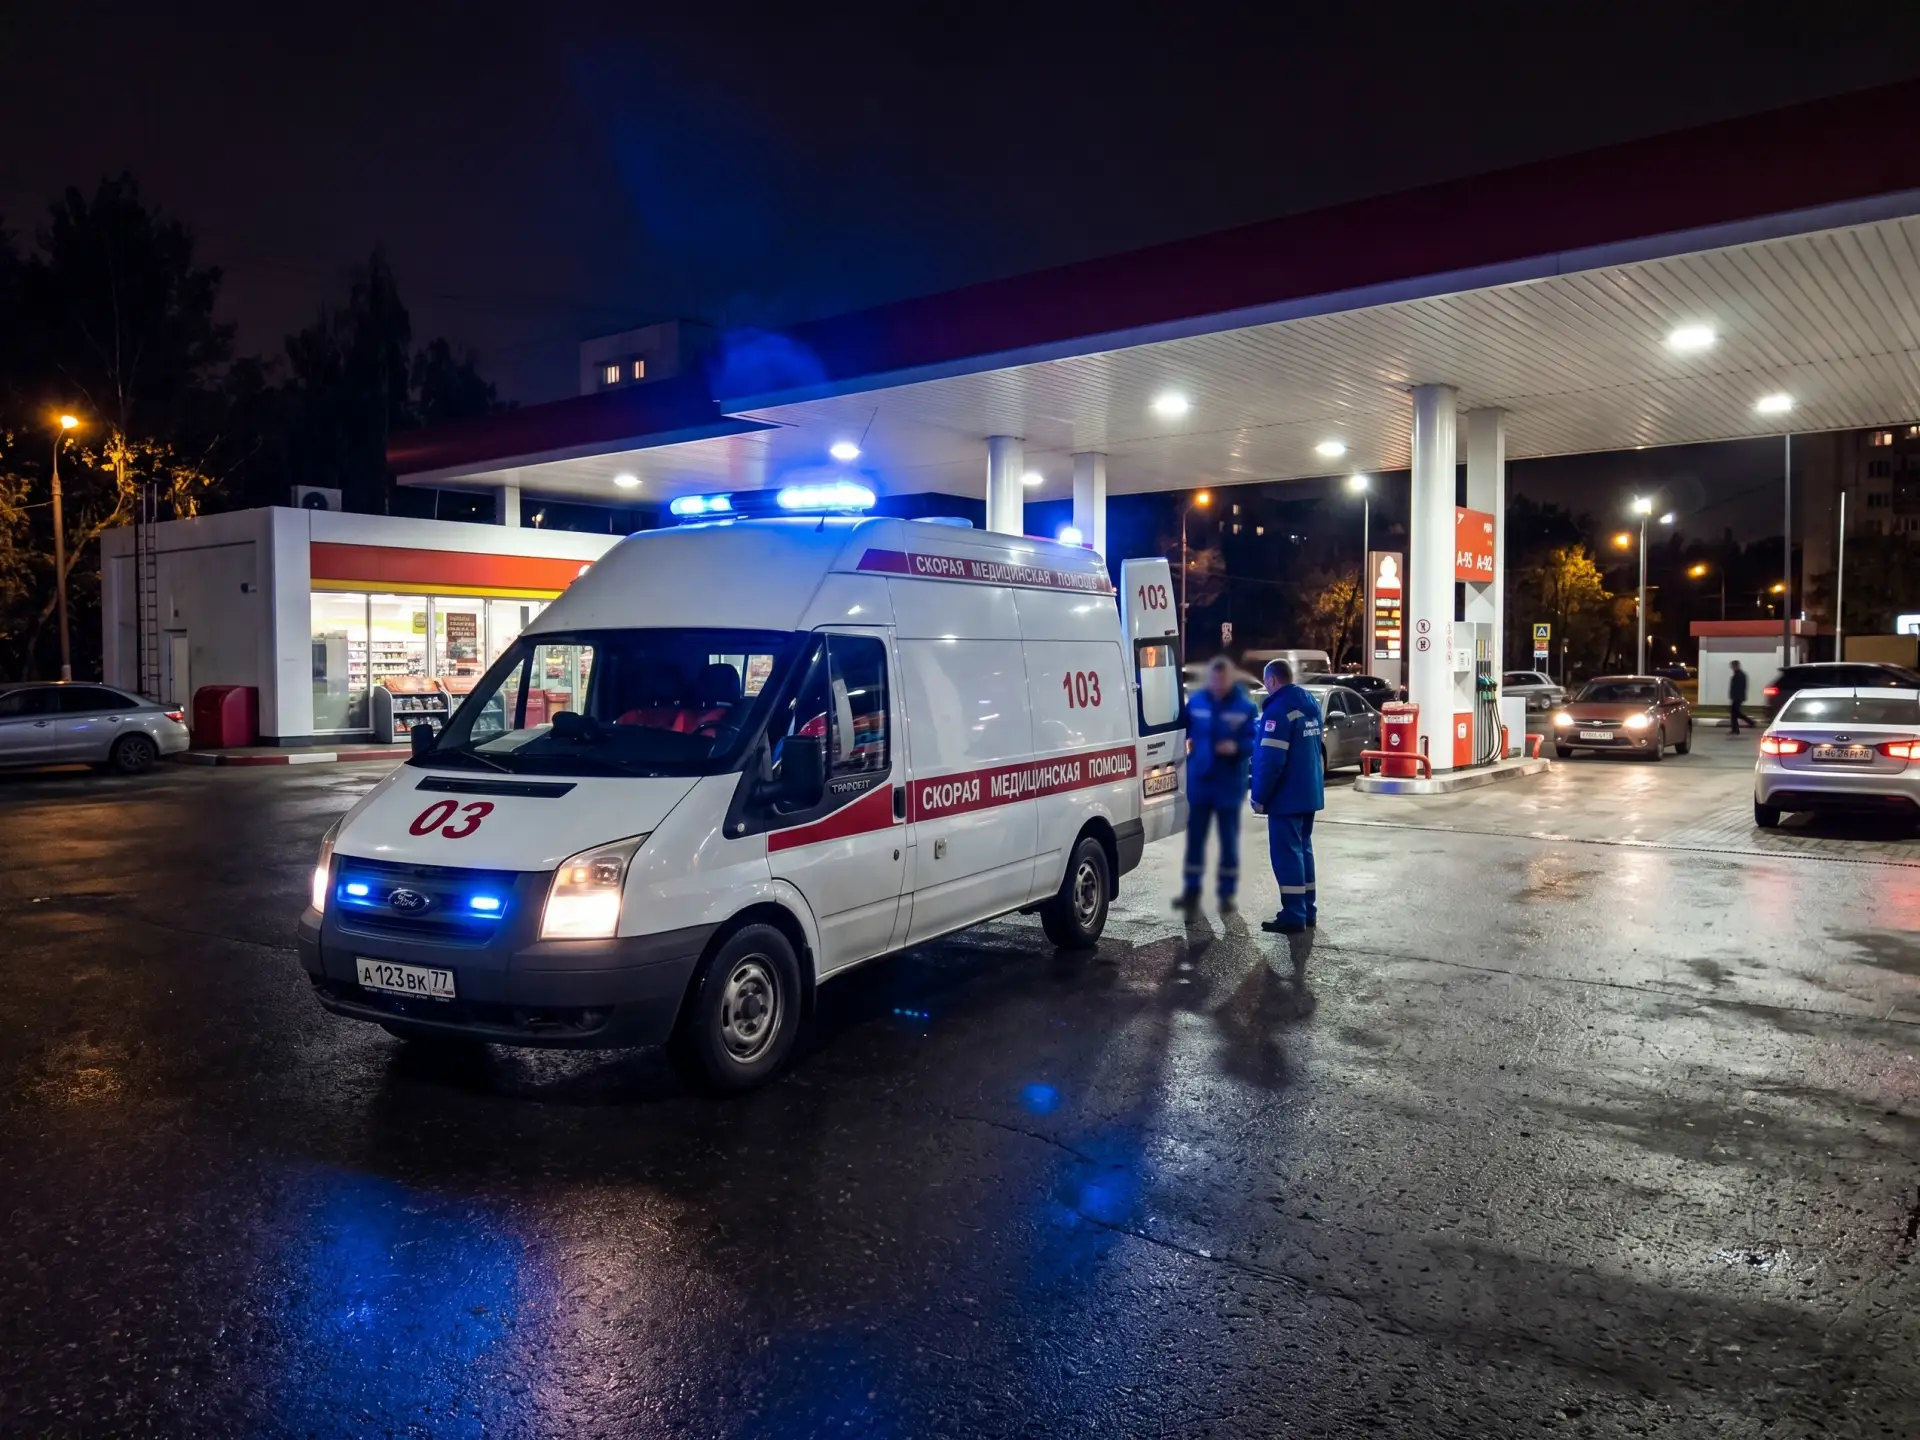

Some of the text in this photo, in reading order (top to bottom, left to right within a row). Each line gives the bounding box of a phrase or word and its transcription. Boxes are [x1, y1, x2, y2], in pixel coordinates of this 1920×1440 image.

[916, 555, 966, 577] СКОРАЯ
[971, 562, 1052, 585] МЕДИЦИНСКАЯ
[1138, 584, 1168, 611] 103
[1062, 670, 1102, 709] 103
[922, 753, 1132, 810] СКОРАЯ МЕДИЦИНСКАЯ ПОМОЩЬ
[408, 799, 495, 840] 03
[430, 970, 448, 989] 77
